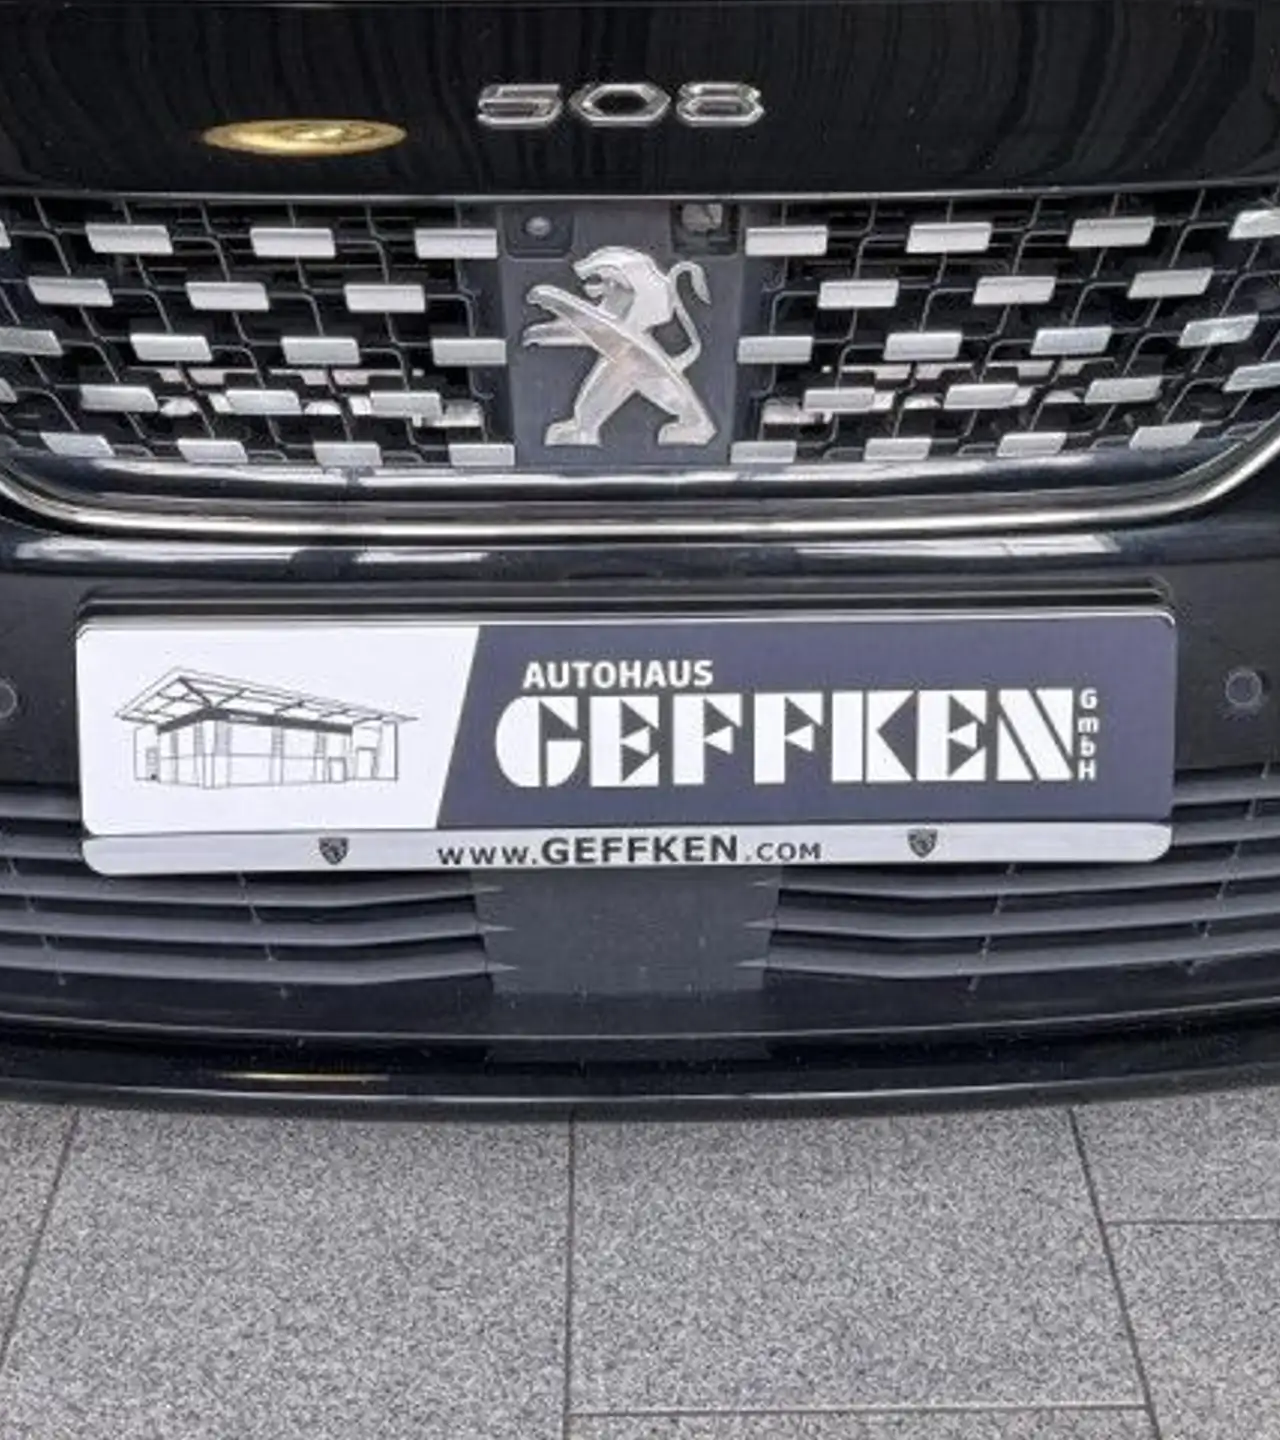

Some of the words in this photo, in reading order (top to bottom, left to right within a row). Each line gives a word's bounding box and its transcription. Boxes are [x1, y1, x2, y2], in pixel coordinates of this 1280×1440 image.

[477, 81, 765, 128] 508
[523, 659, 715, 689] AUTOHAUS
[495, 688, 1074, 788] GEFFKEN
[1077, 687, 1099, 782] GmbH
